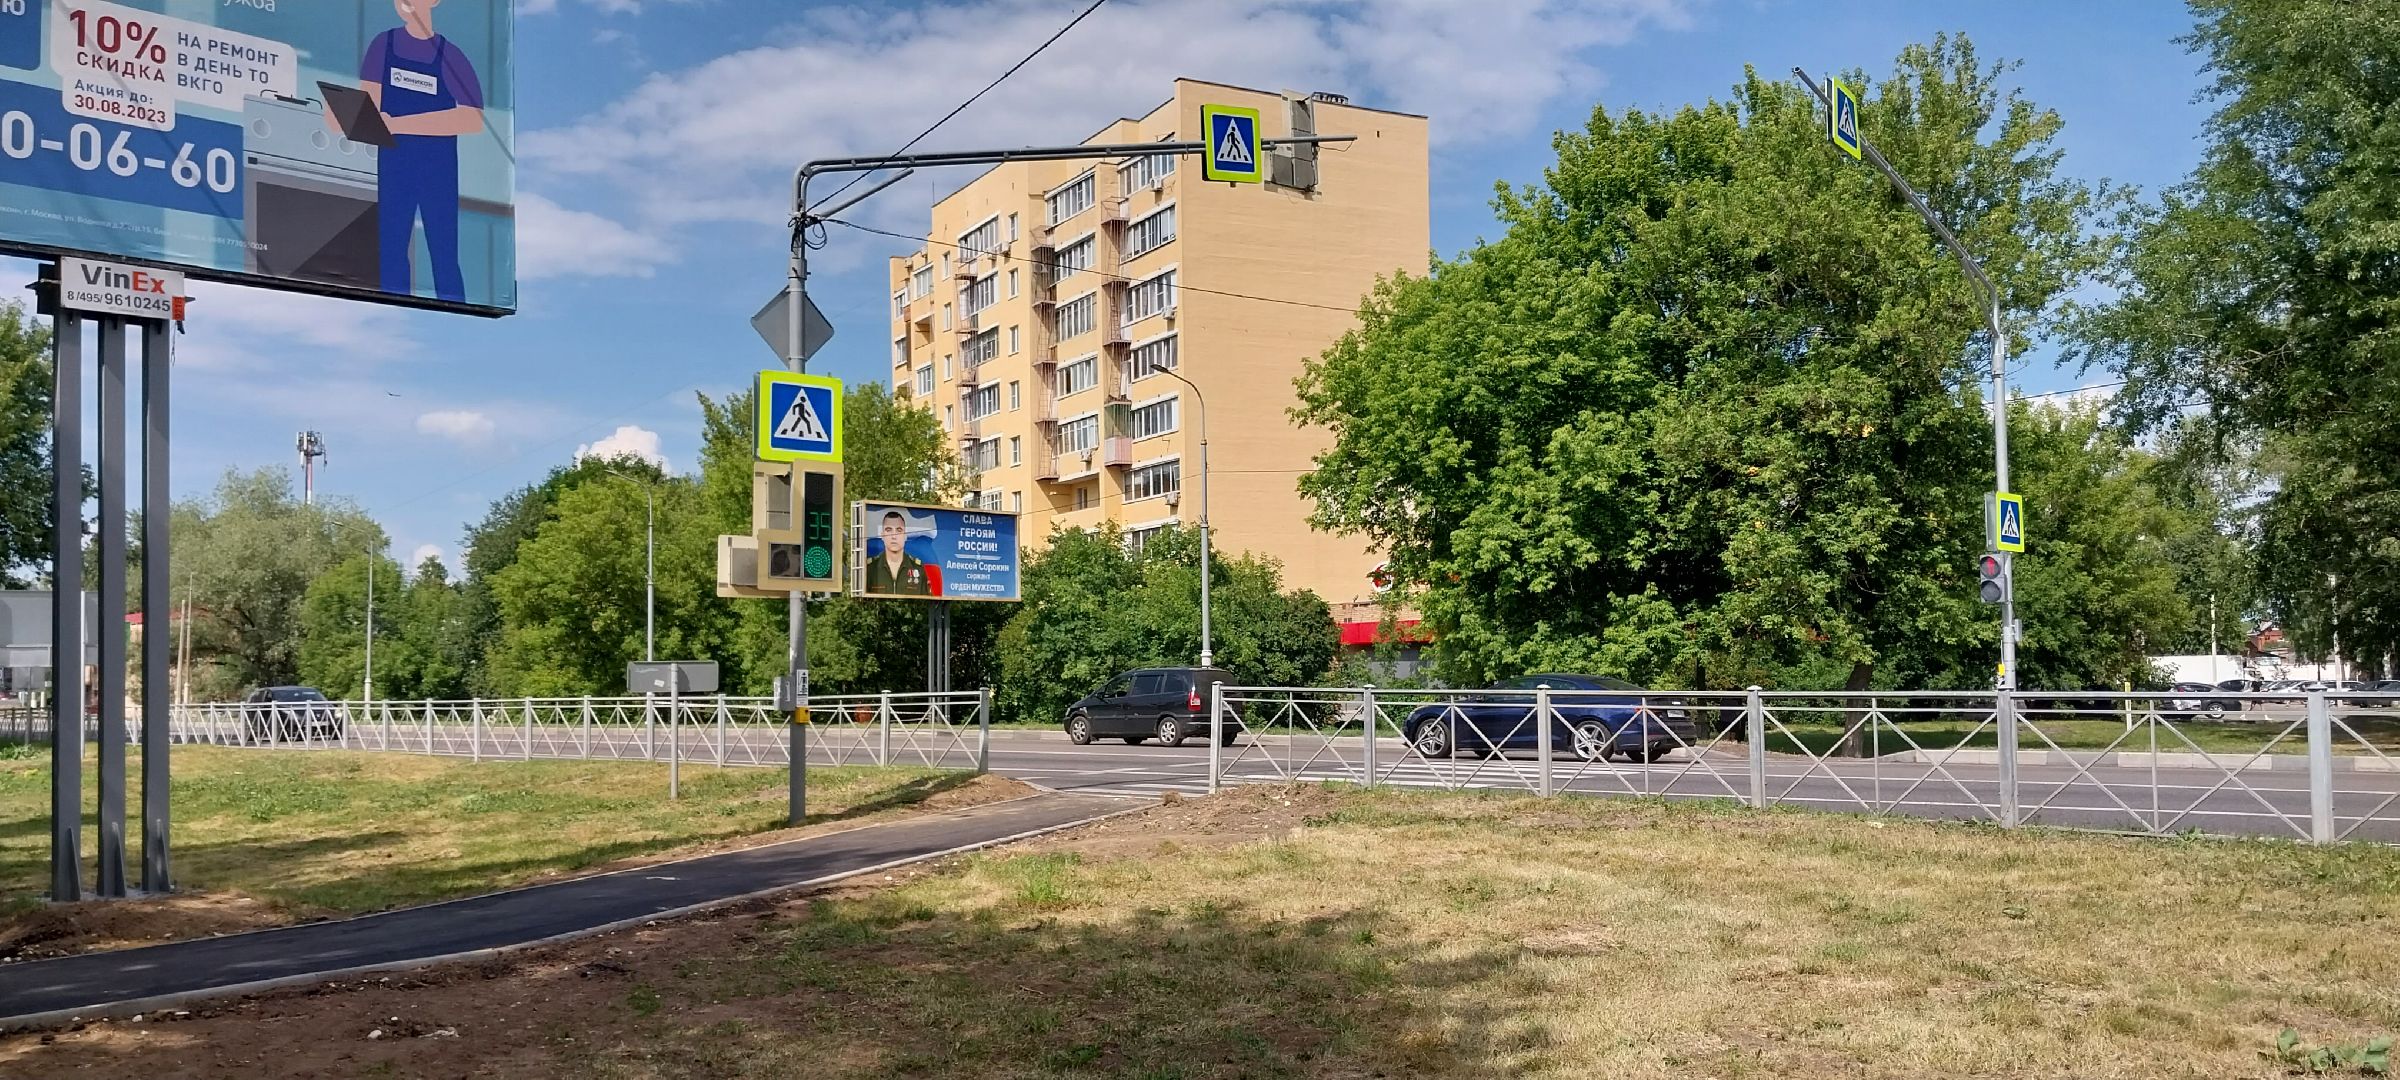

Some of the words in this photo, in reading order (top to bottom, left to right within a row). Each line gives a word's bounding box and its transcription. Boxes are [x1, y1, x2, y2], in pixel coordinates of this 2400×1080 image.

[70, 10, 166, 64] 10%
[178, 32, 202, 50] НА
[208, 39, 279, 66] РЕМОНТ
[77, 51, 165, 82] СКИДКА
[177, 53, 188, 66] В
[194, 57, 242, 78] ДЕНЬ
[249, 68, 269, 84] ТО
[177, 73, 223, 94] ВКГО
[75, 94, 166, 123] 30.08.2023
[2, 110, 235, 193] 0-06-60
[81, 263, 165, 294] VinEx
[809, 511, 831, 540] 35
[960, 527, 996, 539] ГЕРОЯМ
[963, 514, 993, 525] СЛАВА
[958, 541, 998, 552] РОССИИ!
[946, 560, 978, 570] Алексей
[979, 561, 1009, 573] Сорокин
[950, 583, 971, 592] ОРДЕН
[972, 583, 1005, 592] МУЖЕСТВА
